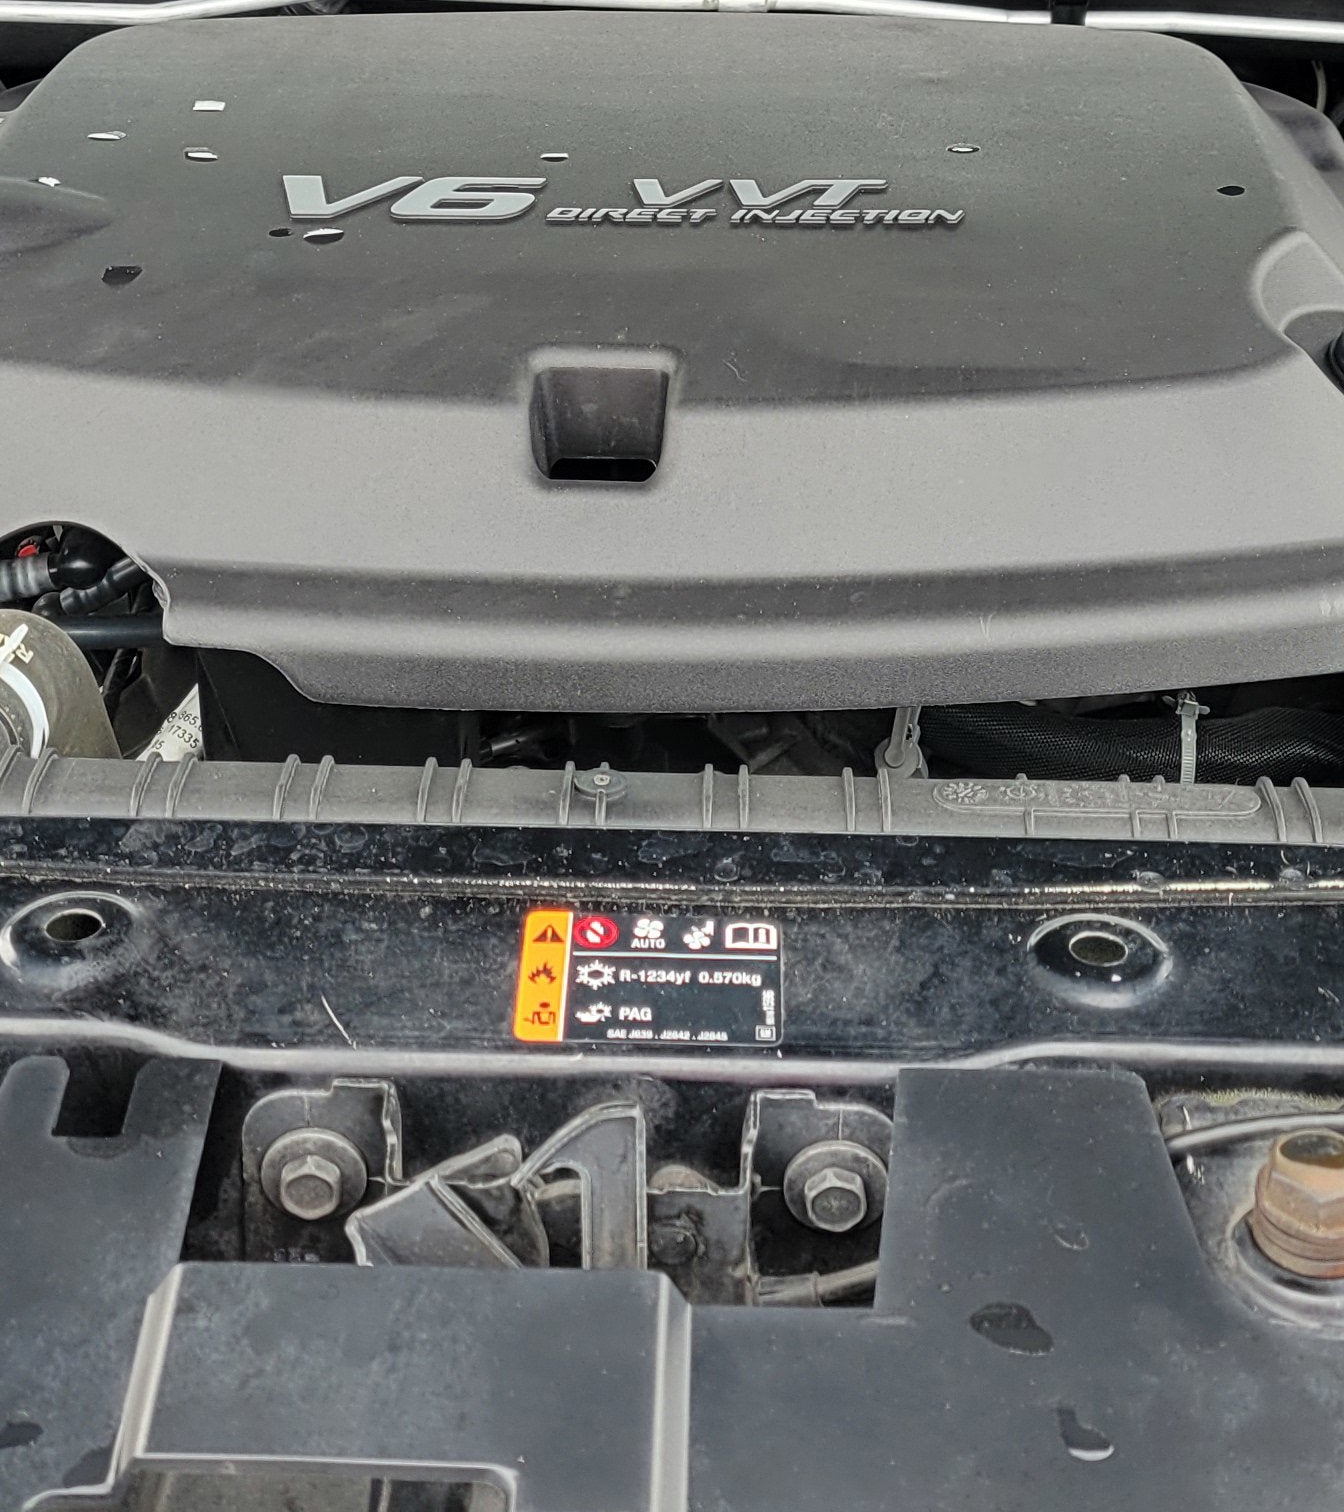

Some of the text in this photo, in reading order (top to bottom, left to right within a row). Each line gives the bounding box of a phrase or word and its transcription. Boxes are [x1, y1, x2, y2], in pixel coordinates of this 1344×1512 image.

[282, 174, 888, 220] V6 VVT
[545, 207, 965, 225] DIRECT INJECTION
[631, 938, 666, 949] AUTO
[619, 969, 762, 986] R-1234yf 0.570kg
[619, 1007, 652, 1021] PAG
